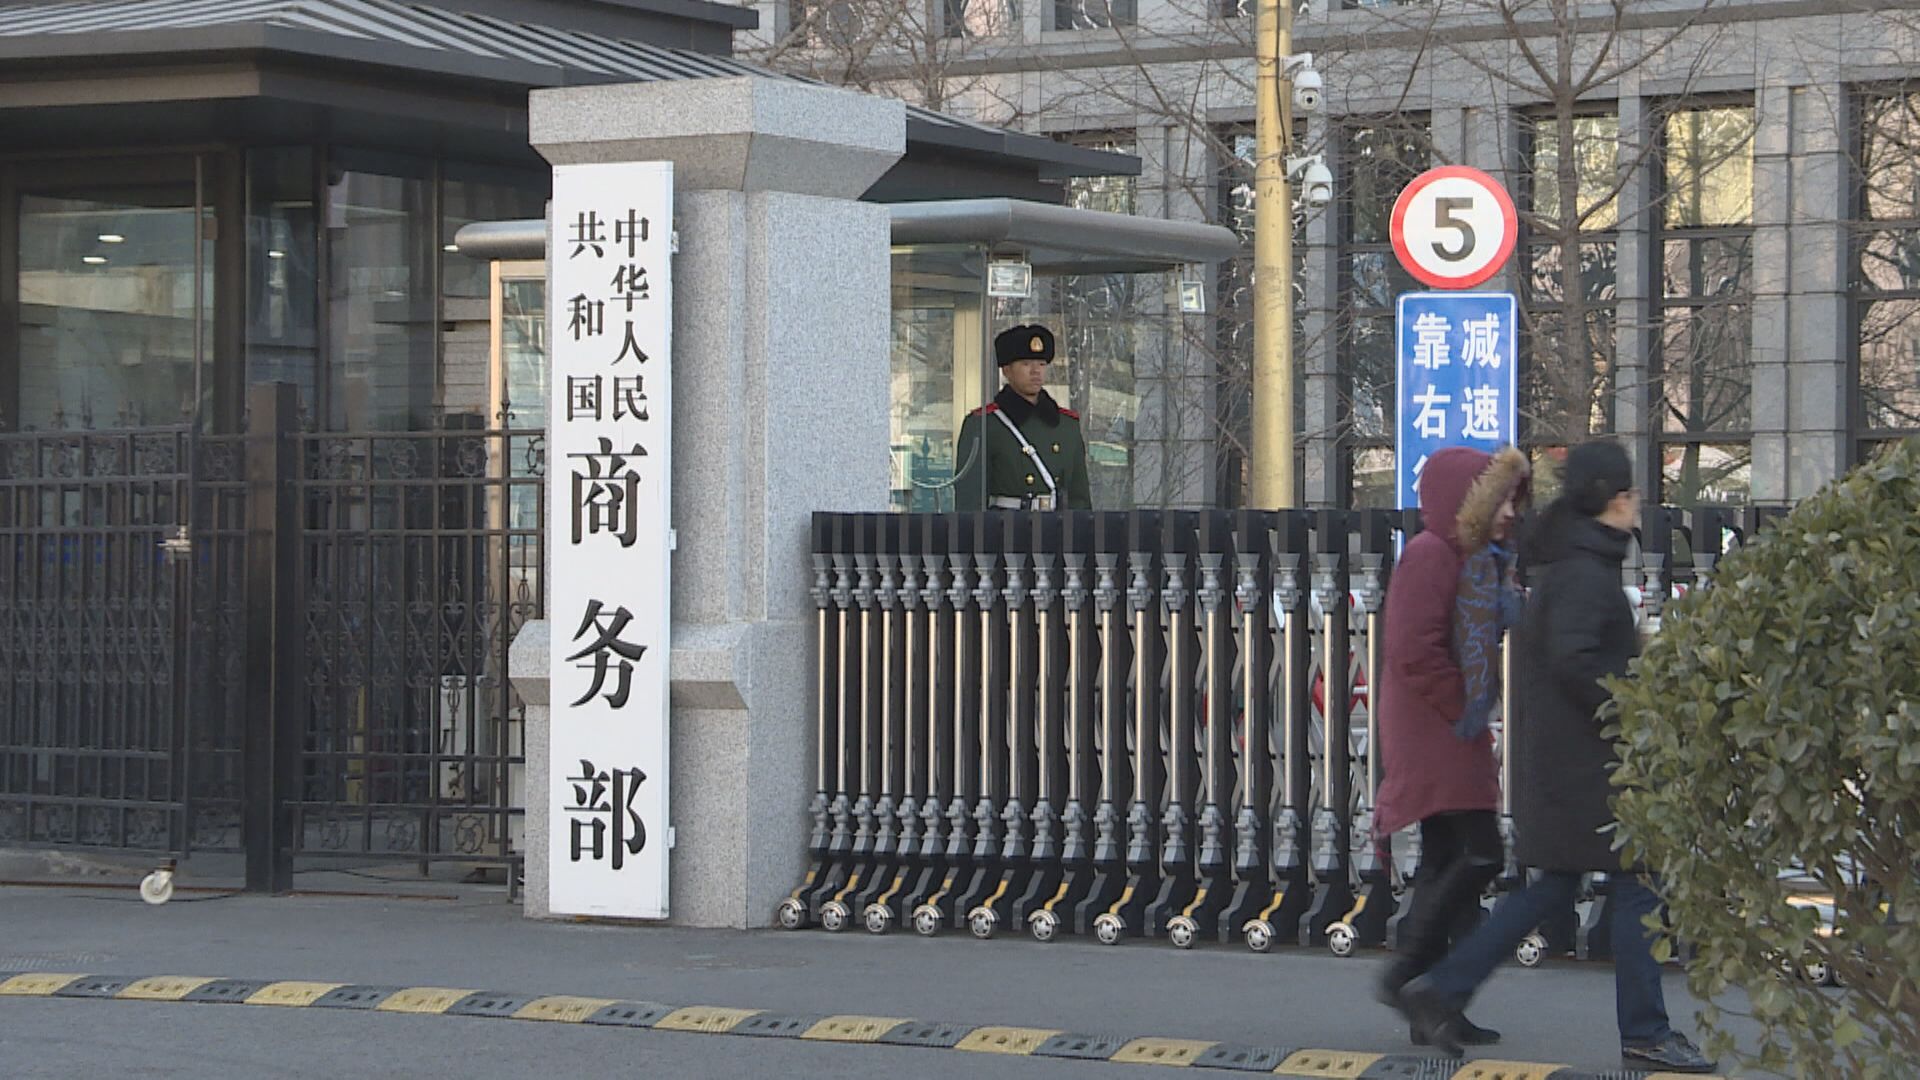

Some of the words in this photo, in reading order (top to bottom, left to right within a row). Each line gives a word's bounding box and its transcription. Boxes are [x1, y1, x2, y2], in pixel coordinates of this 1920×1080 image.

[567, 211, 606, 423] 共和国
[610, 208, 649, 423] 中华人民
[1432, 198, 1476, 262] 5
[1412, 312, 1452, 507] 靠右
[563, 437, 648, 871] 商务部
